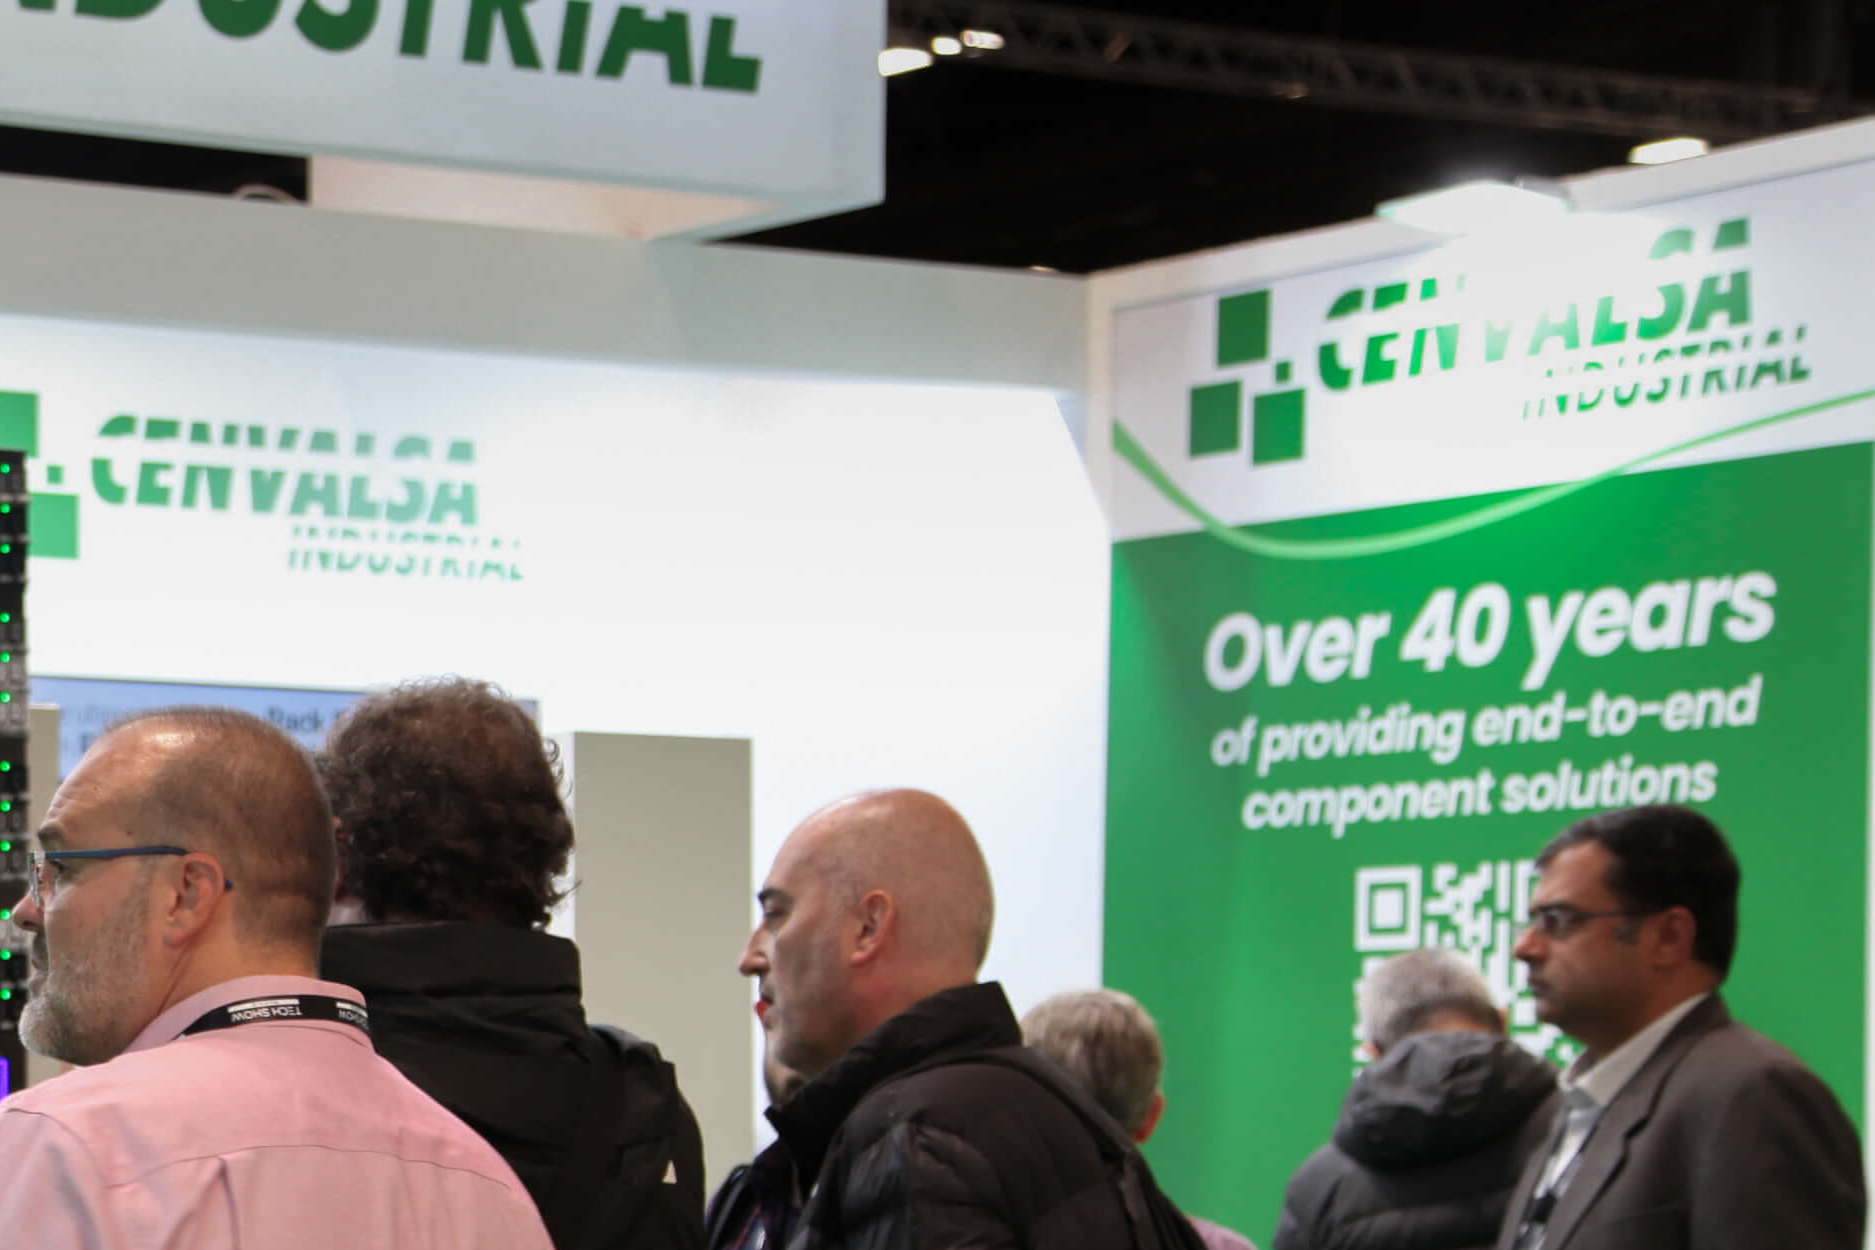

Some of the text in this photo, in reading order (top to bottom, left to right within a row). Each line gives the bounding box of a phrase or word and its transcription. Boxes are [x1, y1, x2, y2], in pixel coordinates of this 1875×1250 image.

[1522, 322, 1811, 420] INDUSTRIAL
[90, 414, 478, 527] CENVALSA
[286, 525, 525, 582] INDUSTRIAL
[1203, 570, 1778, 692] Over 40 years
[1209, 673, 1765, 778] of providing end-to-end
[1241, 753, 1720, 840] component solutions
